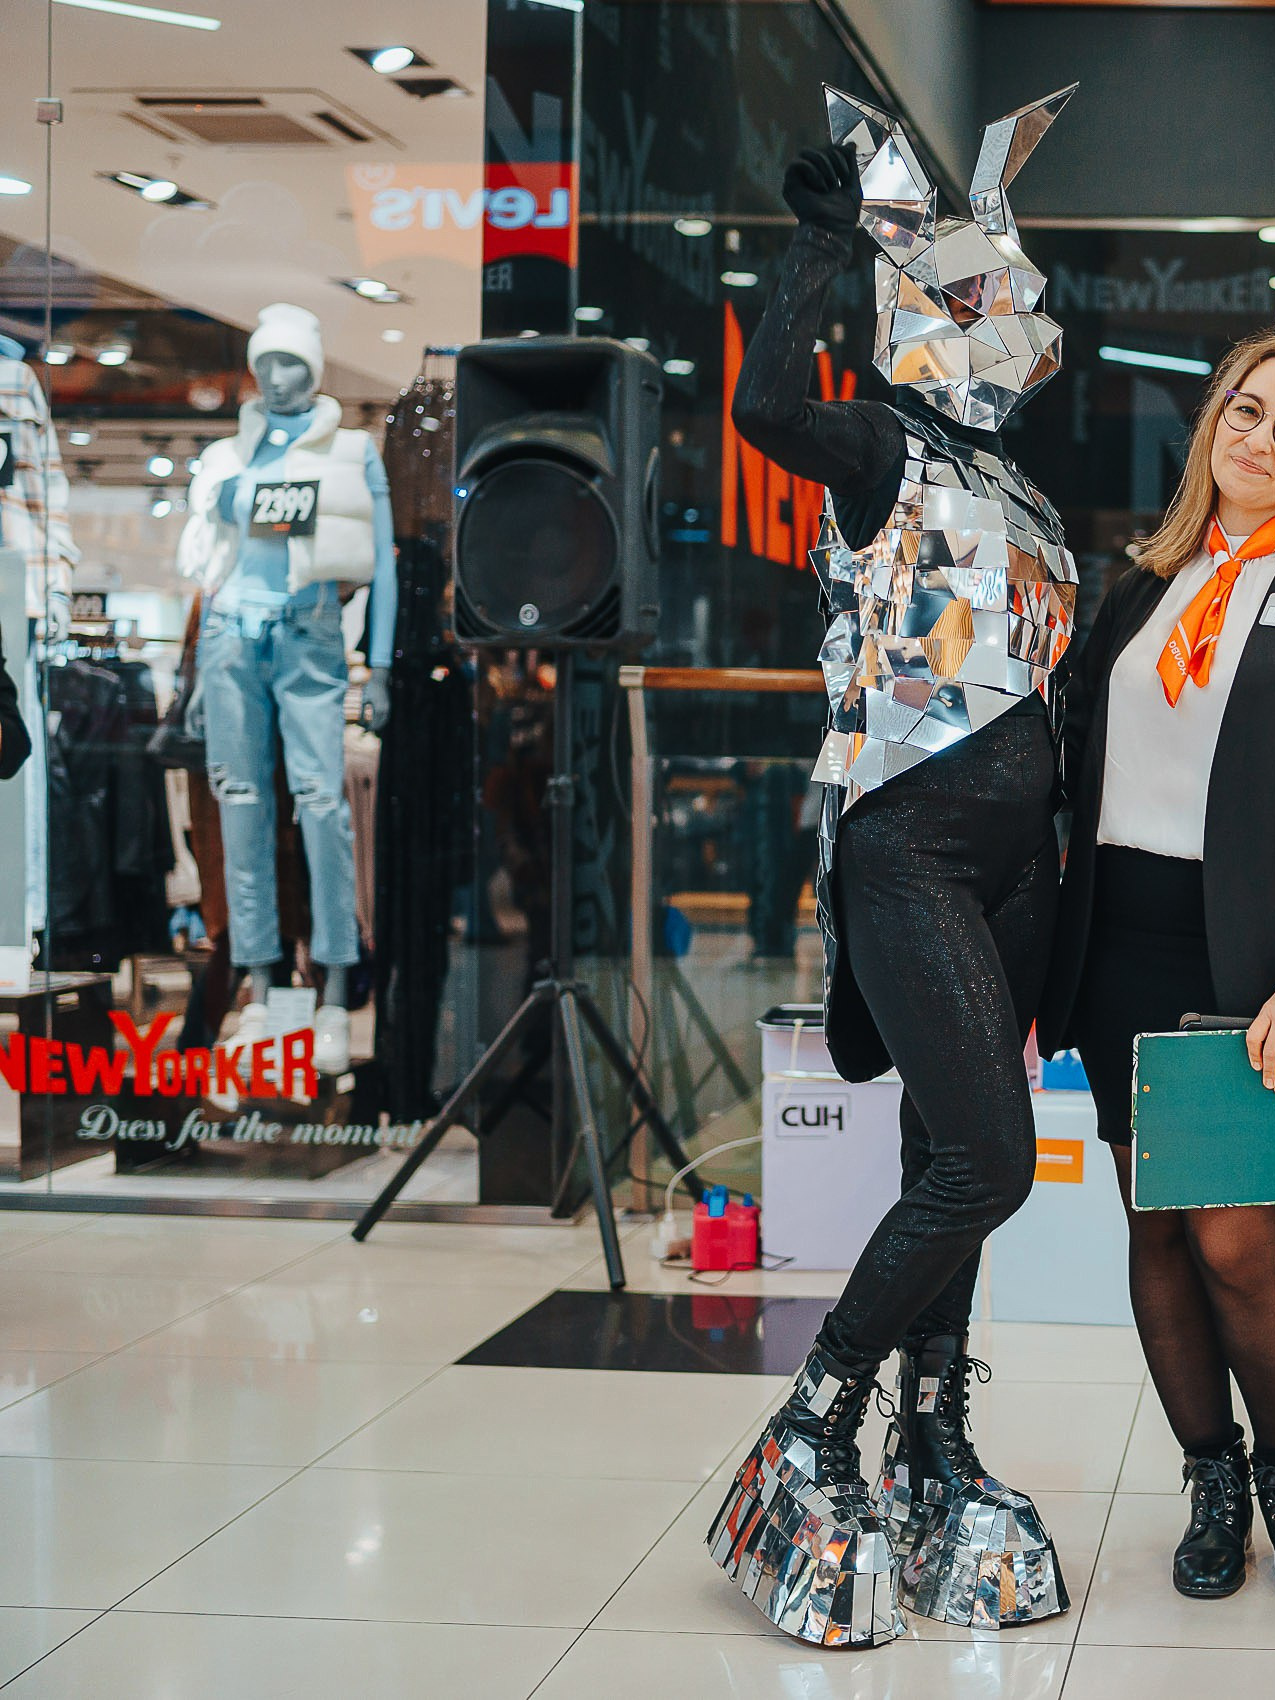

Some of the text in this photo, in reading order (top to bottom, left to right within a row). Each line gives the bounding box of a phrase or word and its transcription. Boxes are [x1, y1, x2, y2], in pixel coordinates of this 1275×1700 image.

[252, 486, 315, 524] 2399
[76, 1105, 165, 1142] Dress
[164, 1108, 220, 1150] for
[233, 1110, 282, 1143] the
